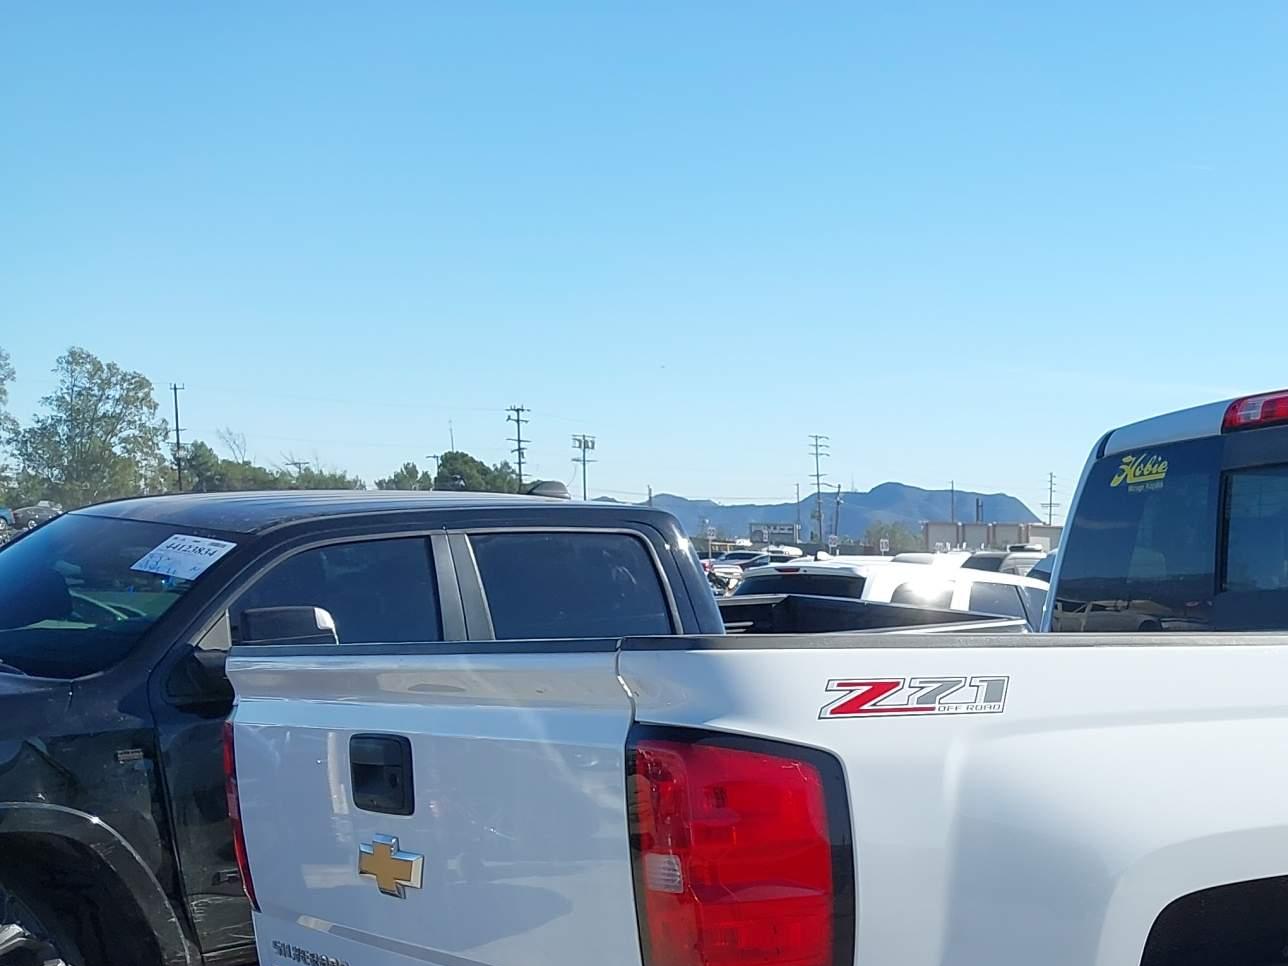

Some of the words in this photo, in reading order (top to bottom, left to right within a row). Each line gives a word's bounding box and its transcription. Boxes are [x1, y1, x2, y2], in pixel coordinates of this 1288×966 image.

[1110, 454, 1168, 487] Hobie
[817, 676, 1010, 720] Z71
[937, 704, 962, 712] OFF
[965, 703, 1001, 712] ROAD
